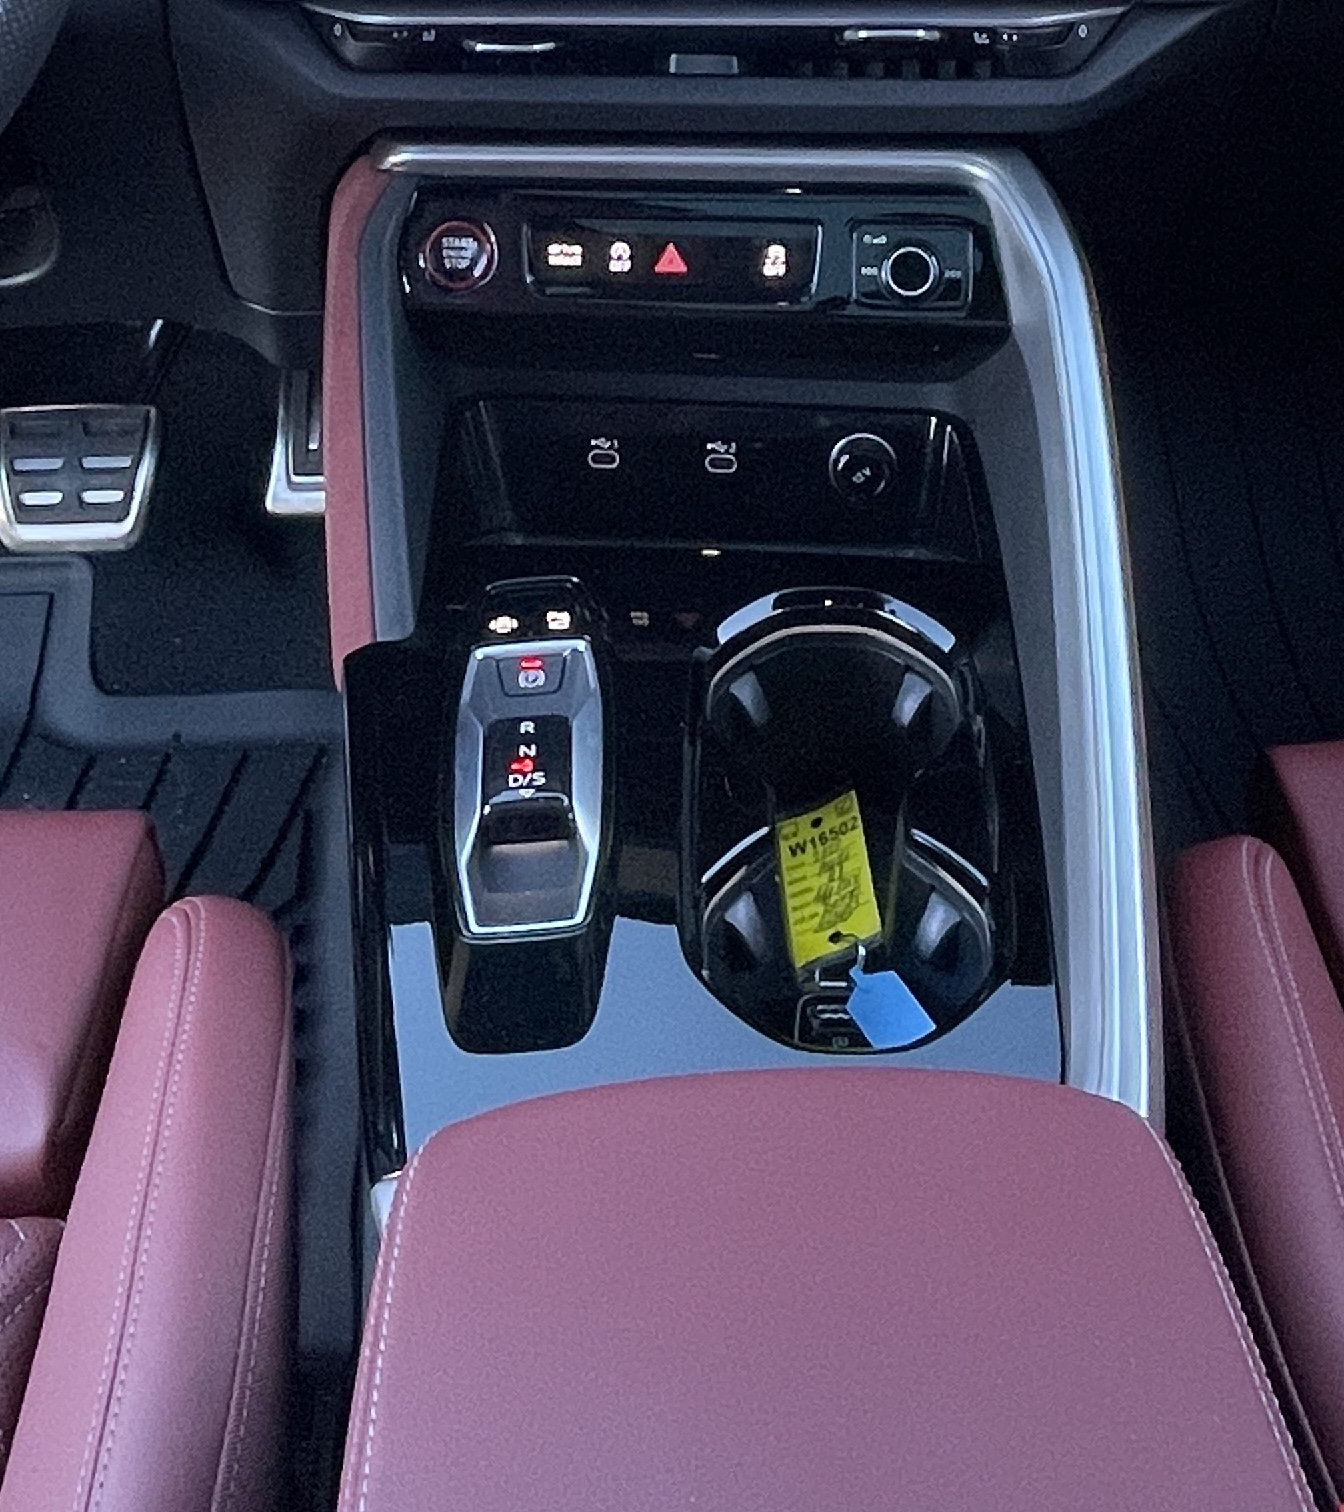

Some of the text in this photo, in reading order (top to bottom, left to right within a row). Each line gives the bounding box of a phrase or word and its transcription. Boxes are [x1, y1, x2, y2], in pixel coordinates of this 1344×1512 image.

[519, 720, 536, 734] R
[518, 743, 537, 758] N
[508, 770, 547, 788] D/S
[787, 814, 858, 858] W16502
